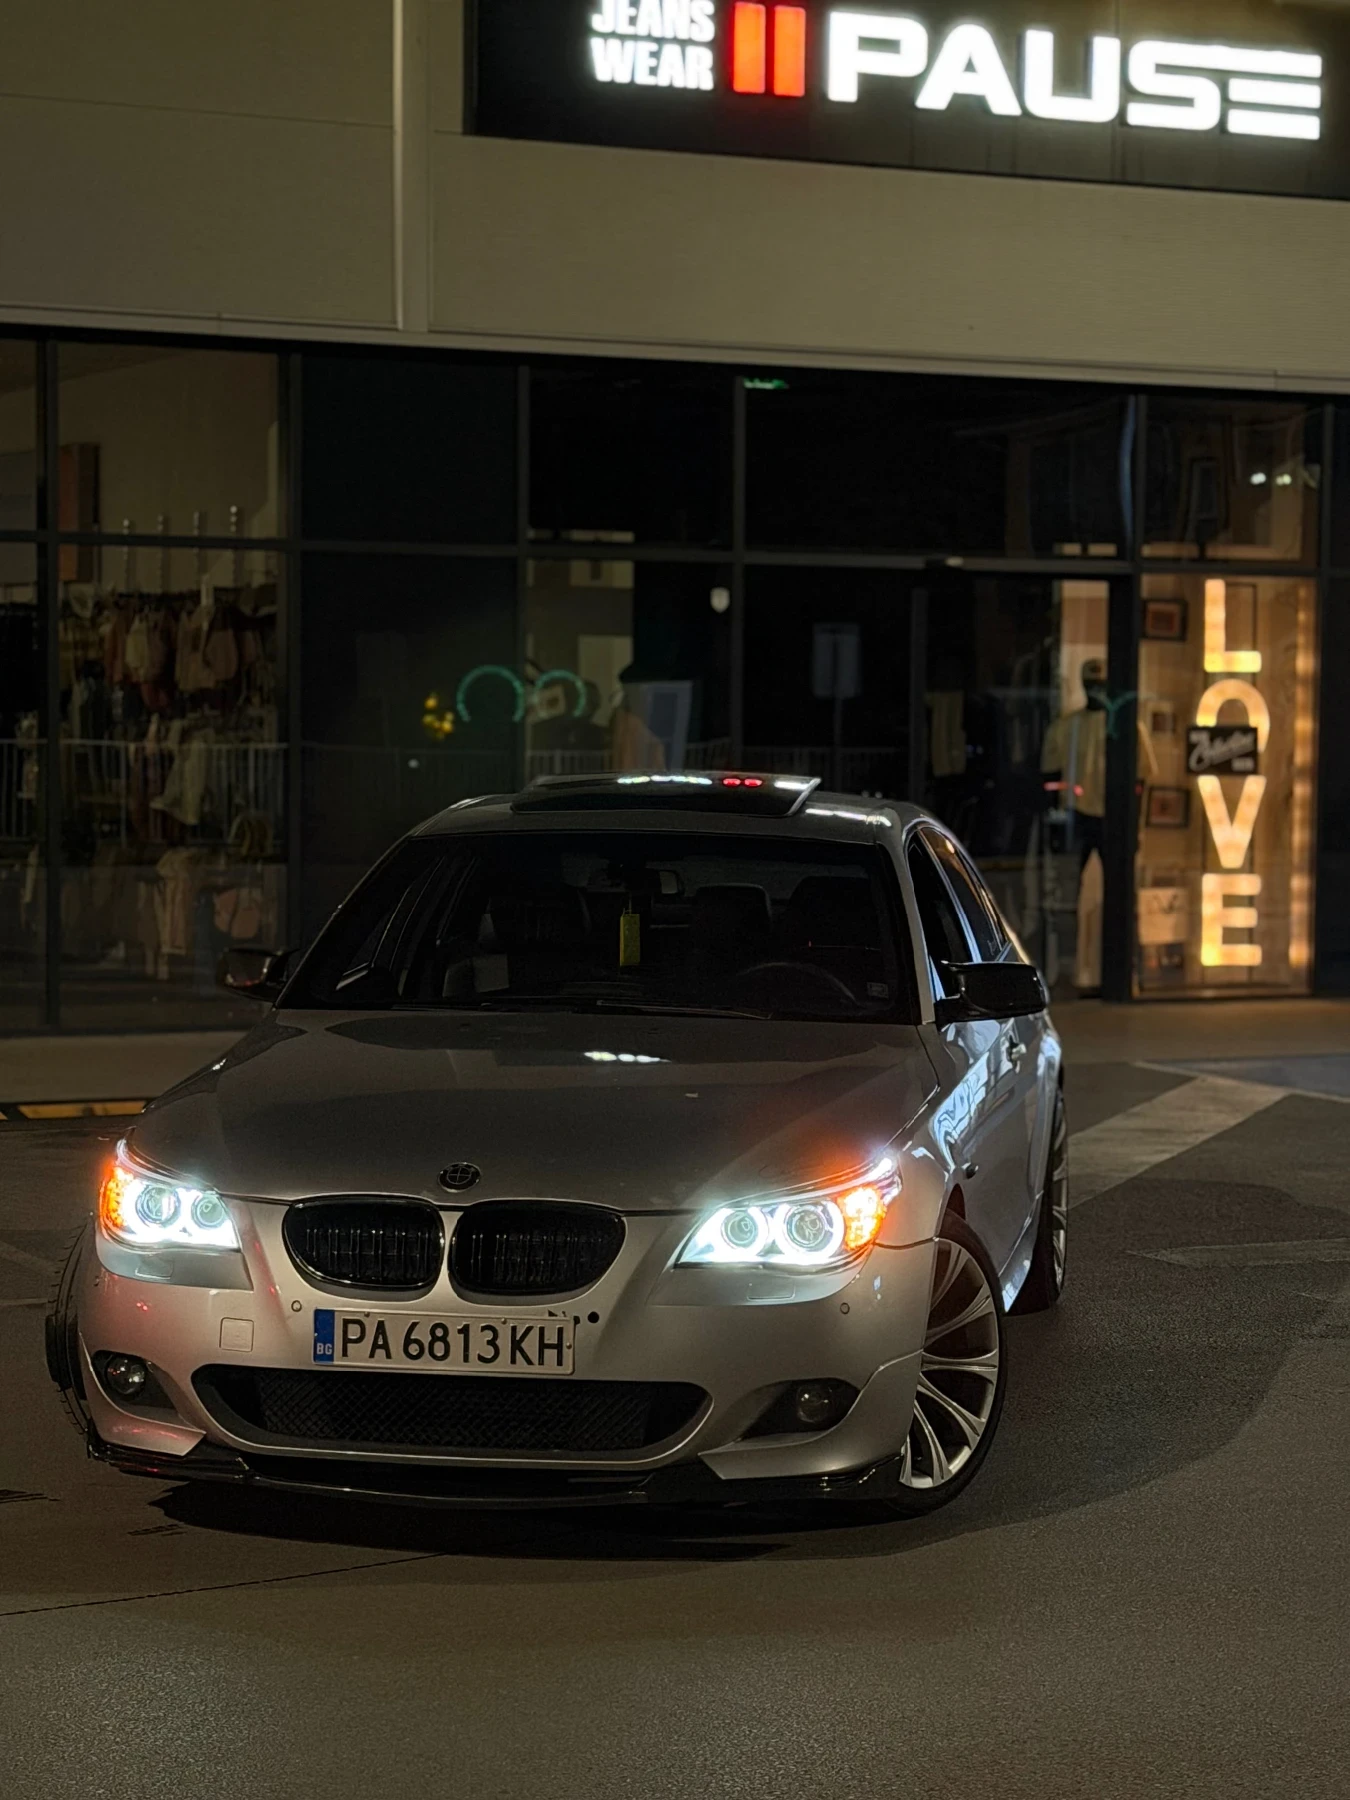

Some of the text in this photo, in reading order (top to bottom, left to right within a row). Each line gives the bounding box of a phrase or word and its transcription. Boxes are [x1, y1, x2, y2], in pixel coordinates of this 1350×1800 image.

[591, 0, 715, 42] JEANS
[590, 37, 714, 91] WEAR
[827, 10, 1322, 140] PAUSE
[316, 1342, 333, 1355] BG
[341, 1317, 564, 1366] PA 6813 KH
